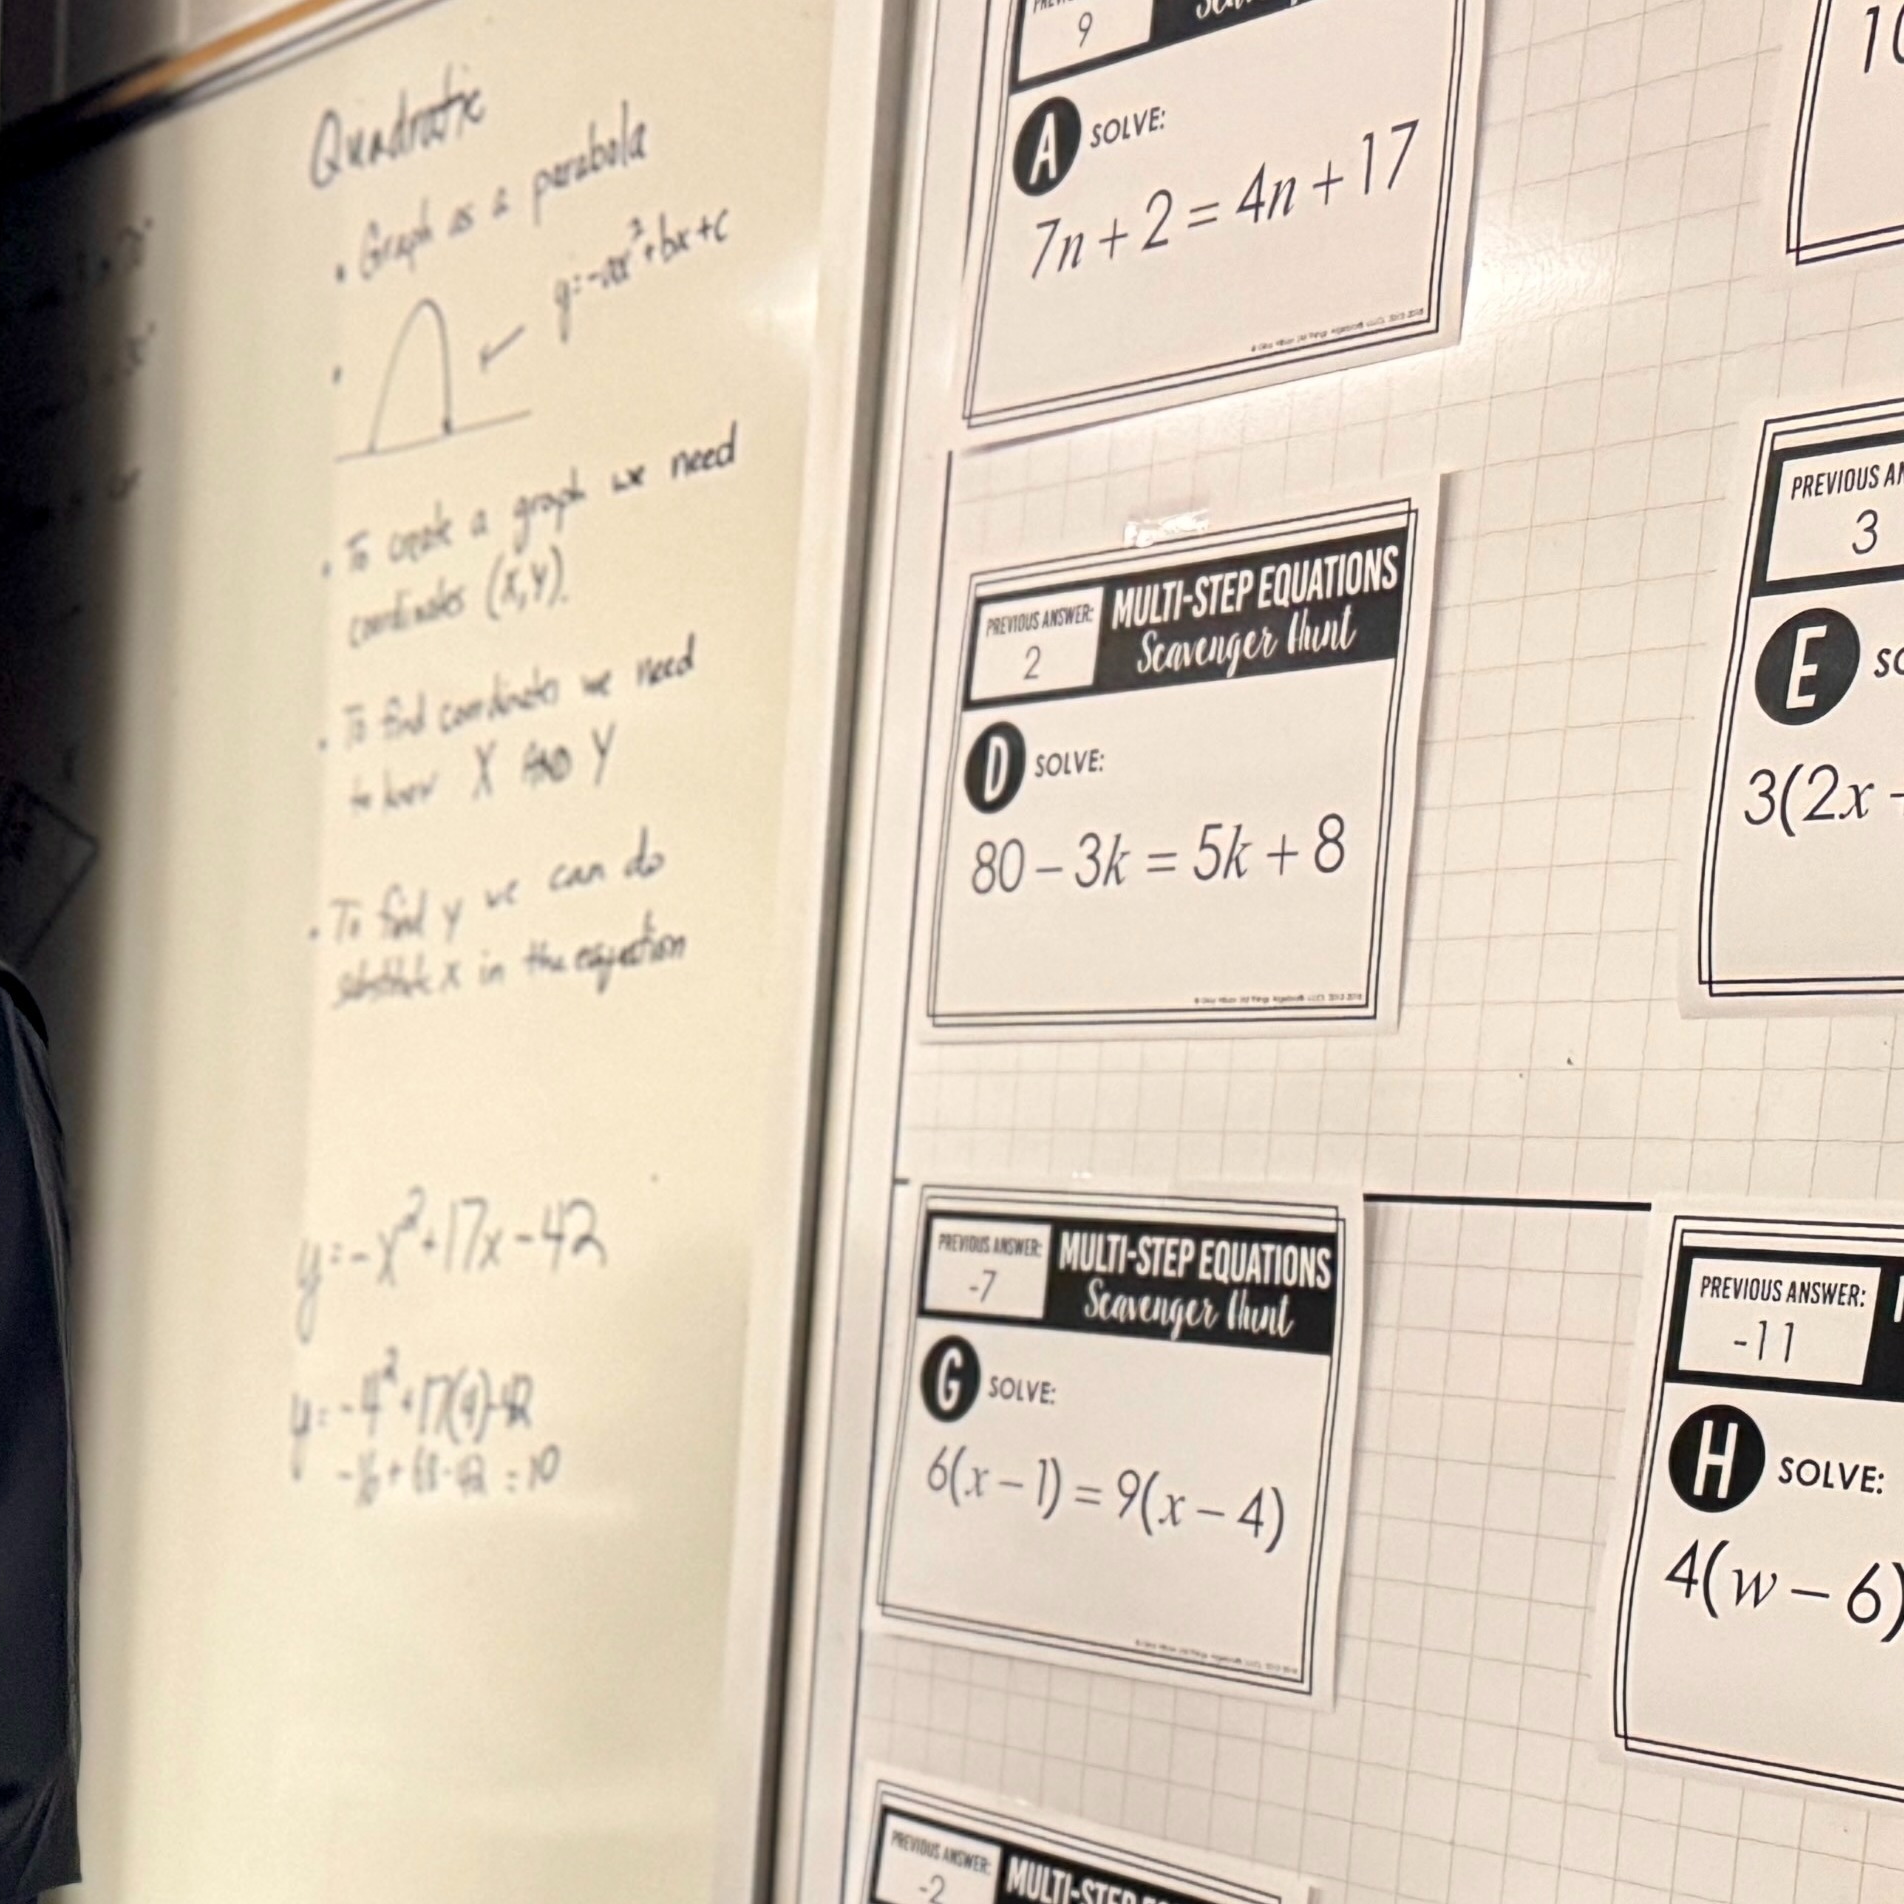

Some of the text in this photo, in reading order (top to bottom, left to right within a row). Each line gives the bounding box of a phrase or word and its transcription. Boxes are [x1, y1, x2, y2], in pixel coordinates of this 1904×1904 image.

[1078, 11, 1093, 48] 9
[1028, 106, 1167, 186] A SOLVE:
[358, 197, 434, 283] Graph
[532, 99, 647, 228] parabola
[512, 465, 588, 556] graph
[670, 419, 738, 480] need
[1790, 463, 1881, 501] PREVIOUS
[1851, 508, 1881, 556] 3
[1111, 545, 1400, 630] MULTI-STEP EQUATIONS
[985, 604, 1095, 638] PREVIOUS ANSWER:
[1136, 604, 1359, 680] Scavenger Hunt
[635, 631, 696, 687] need
[1022, 646, 1042, 680] 2
[1785, 624, 1829, 711] E
[984, 736, 1107, 802] D SOLVE:
[376, 883, 429, 940] find
[546, 862, 608, 892] can
[622, 824, 667, 878] do
[478, 949, 505, 987] in
[522, 940, 567, 976] the
[937, 1232, 1044, 1258] PREVIOUS ANSWER:
[1058, 1230, 1333, 1290] MULTI-STEP EQUATIONS
[968, 1269, 998, 1304] -7
[1083, 1276, 1296, 1342] Scavenger Hunt
[1699, 1275, 1784, 1305] PREVIOUS
[1785, 1279, 1868, 1309] ANSWER:
[1732, 1318, 1797, 1364] -11
[934, 1346, 1058, 1413] G SOLVE:
[1692, 1418, 1886, 1501] H SOLVE:
[890, 1830, 993, 1877] PREVIOUS ANSWER:
